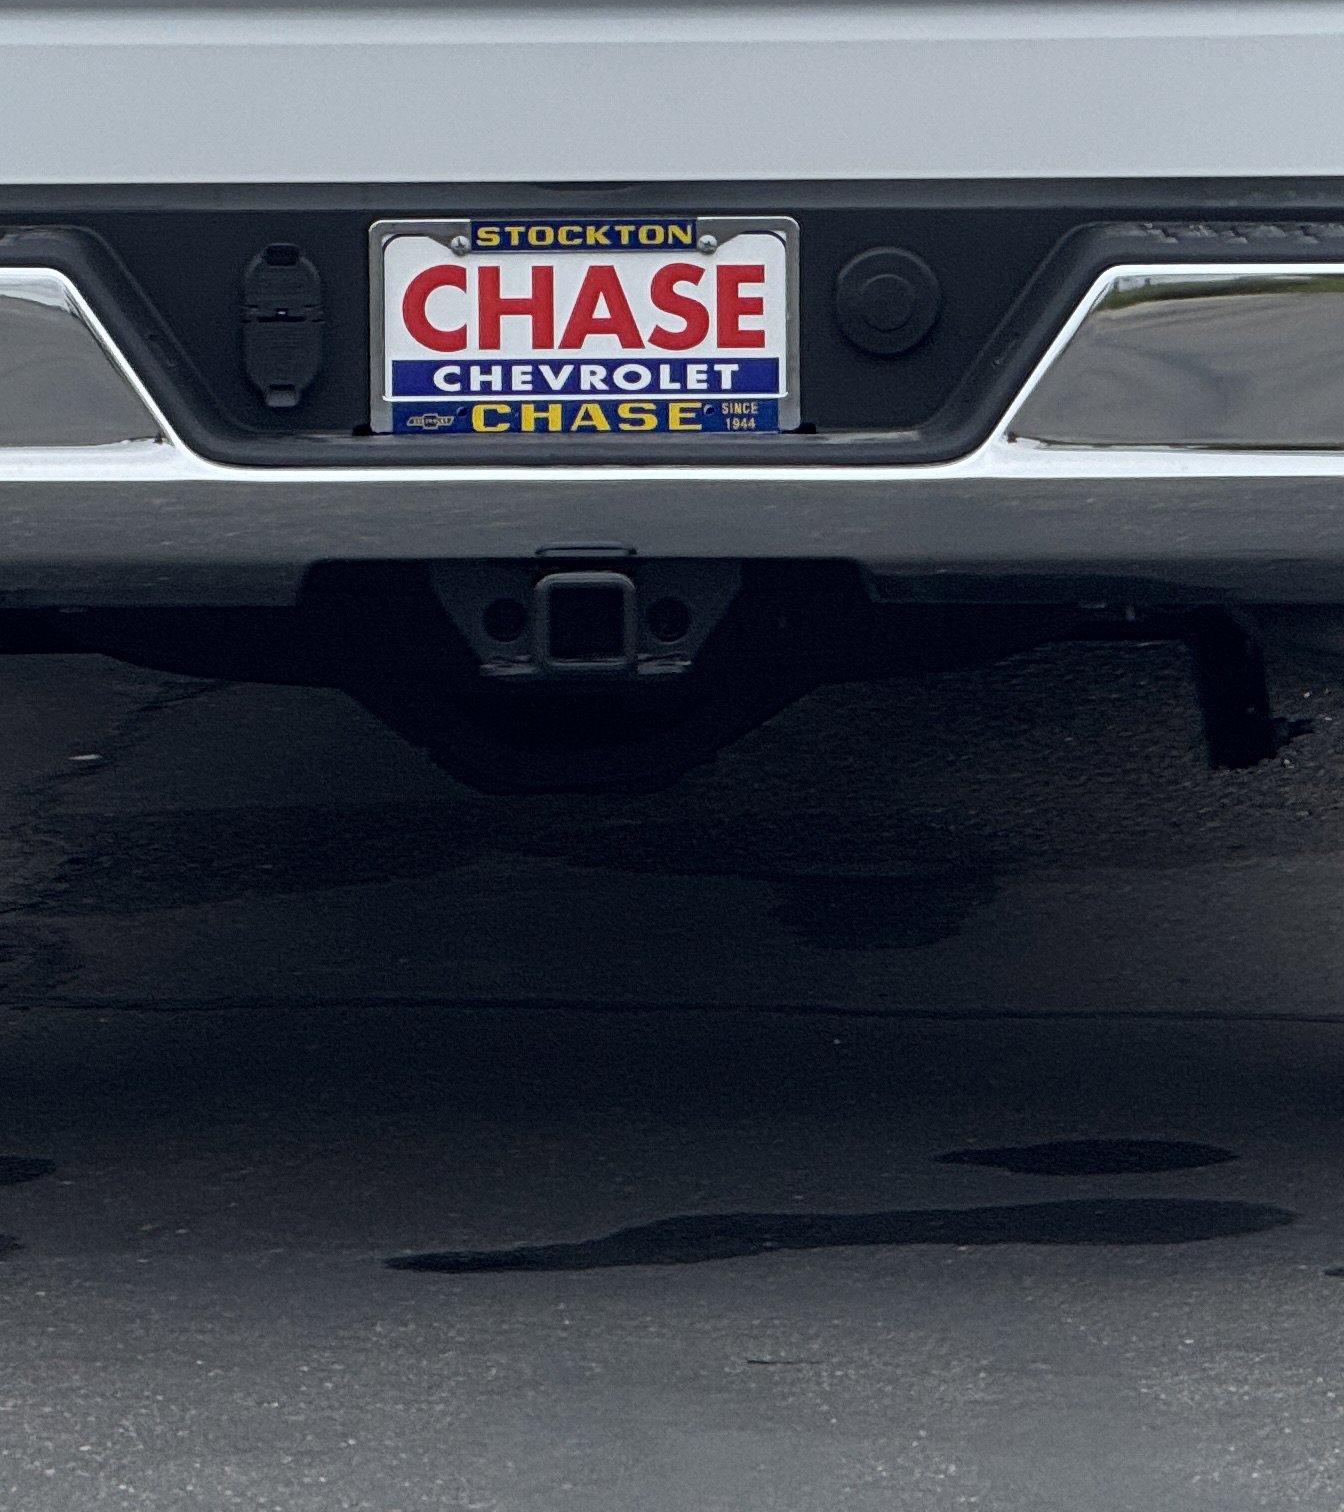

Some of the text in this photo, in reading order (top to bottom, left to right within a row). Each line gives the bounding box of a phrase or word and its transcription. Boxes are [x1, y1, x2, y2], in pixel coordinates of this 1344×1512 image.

[475, 224, 692, 246] STOCKTON
[402, 262, 766, 352] CHASE
[433, 363, 739, 392] CHEVROLET
[472, 402, 703, 432] CHASE
[721, 402, 759, 415] SINCE
[726, 417, 756, 431] 1944
